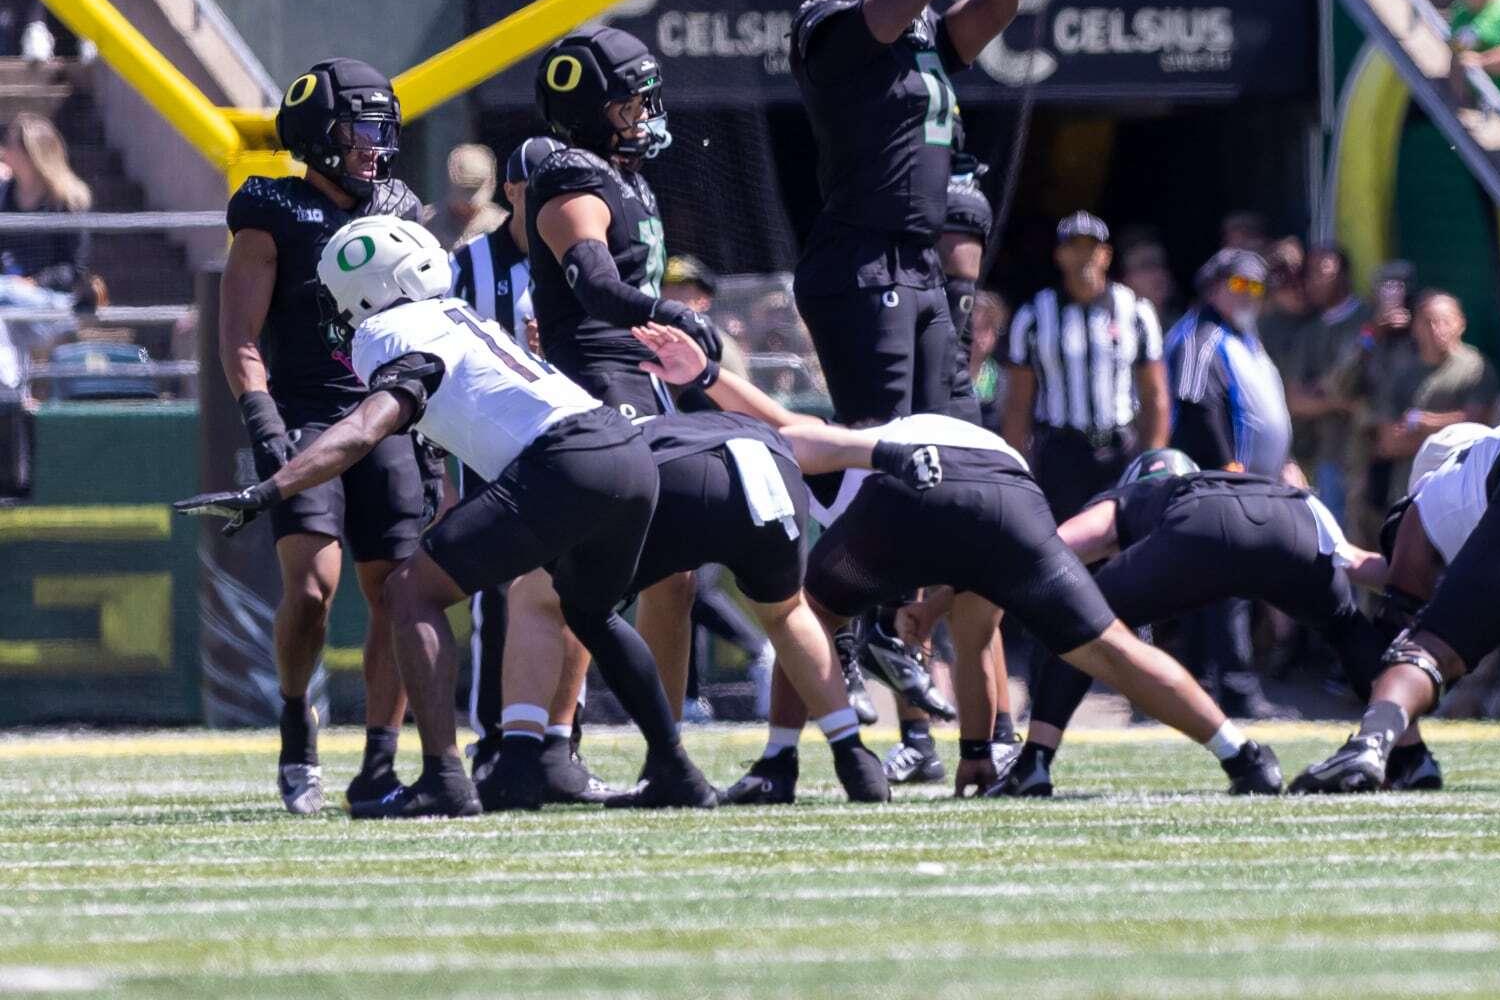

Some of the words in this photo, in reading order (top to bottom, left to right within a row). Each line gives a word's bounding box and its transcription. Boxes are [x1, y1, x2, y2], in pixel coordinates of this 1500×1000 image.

[657, 10, 793, 57] CELSI
[1053, 6, 1233, 53] CELSIUS
[285, 74, 317, 106] O
[546, 54, 582, 92] O
[336, 235, 376, 272] O
[497, 279, 508, 295] S
